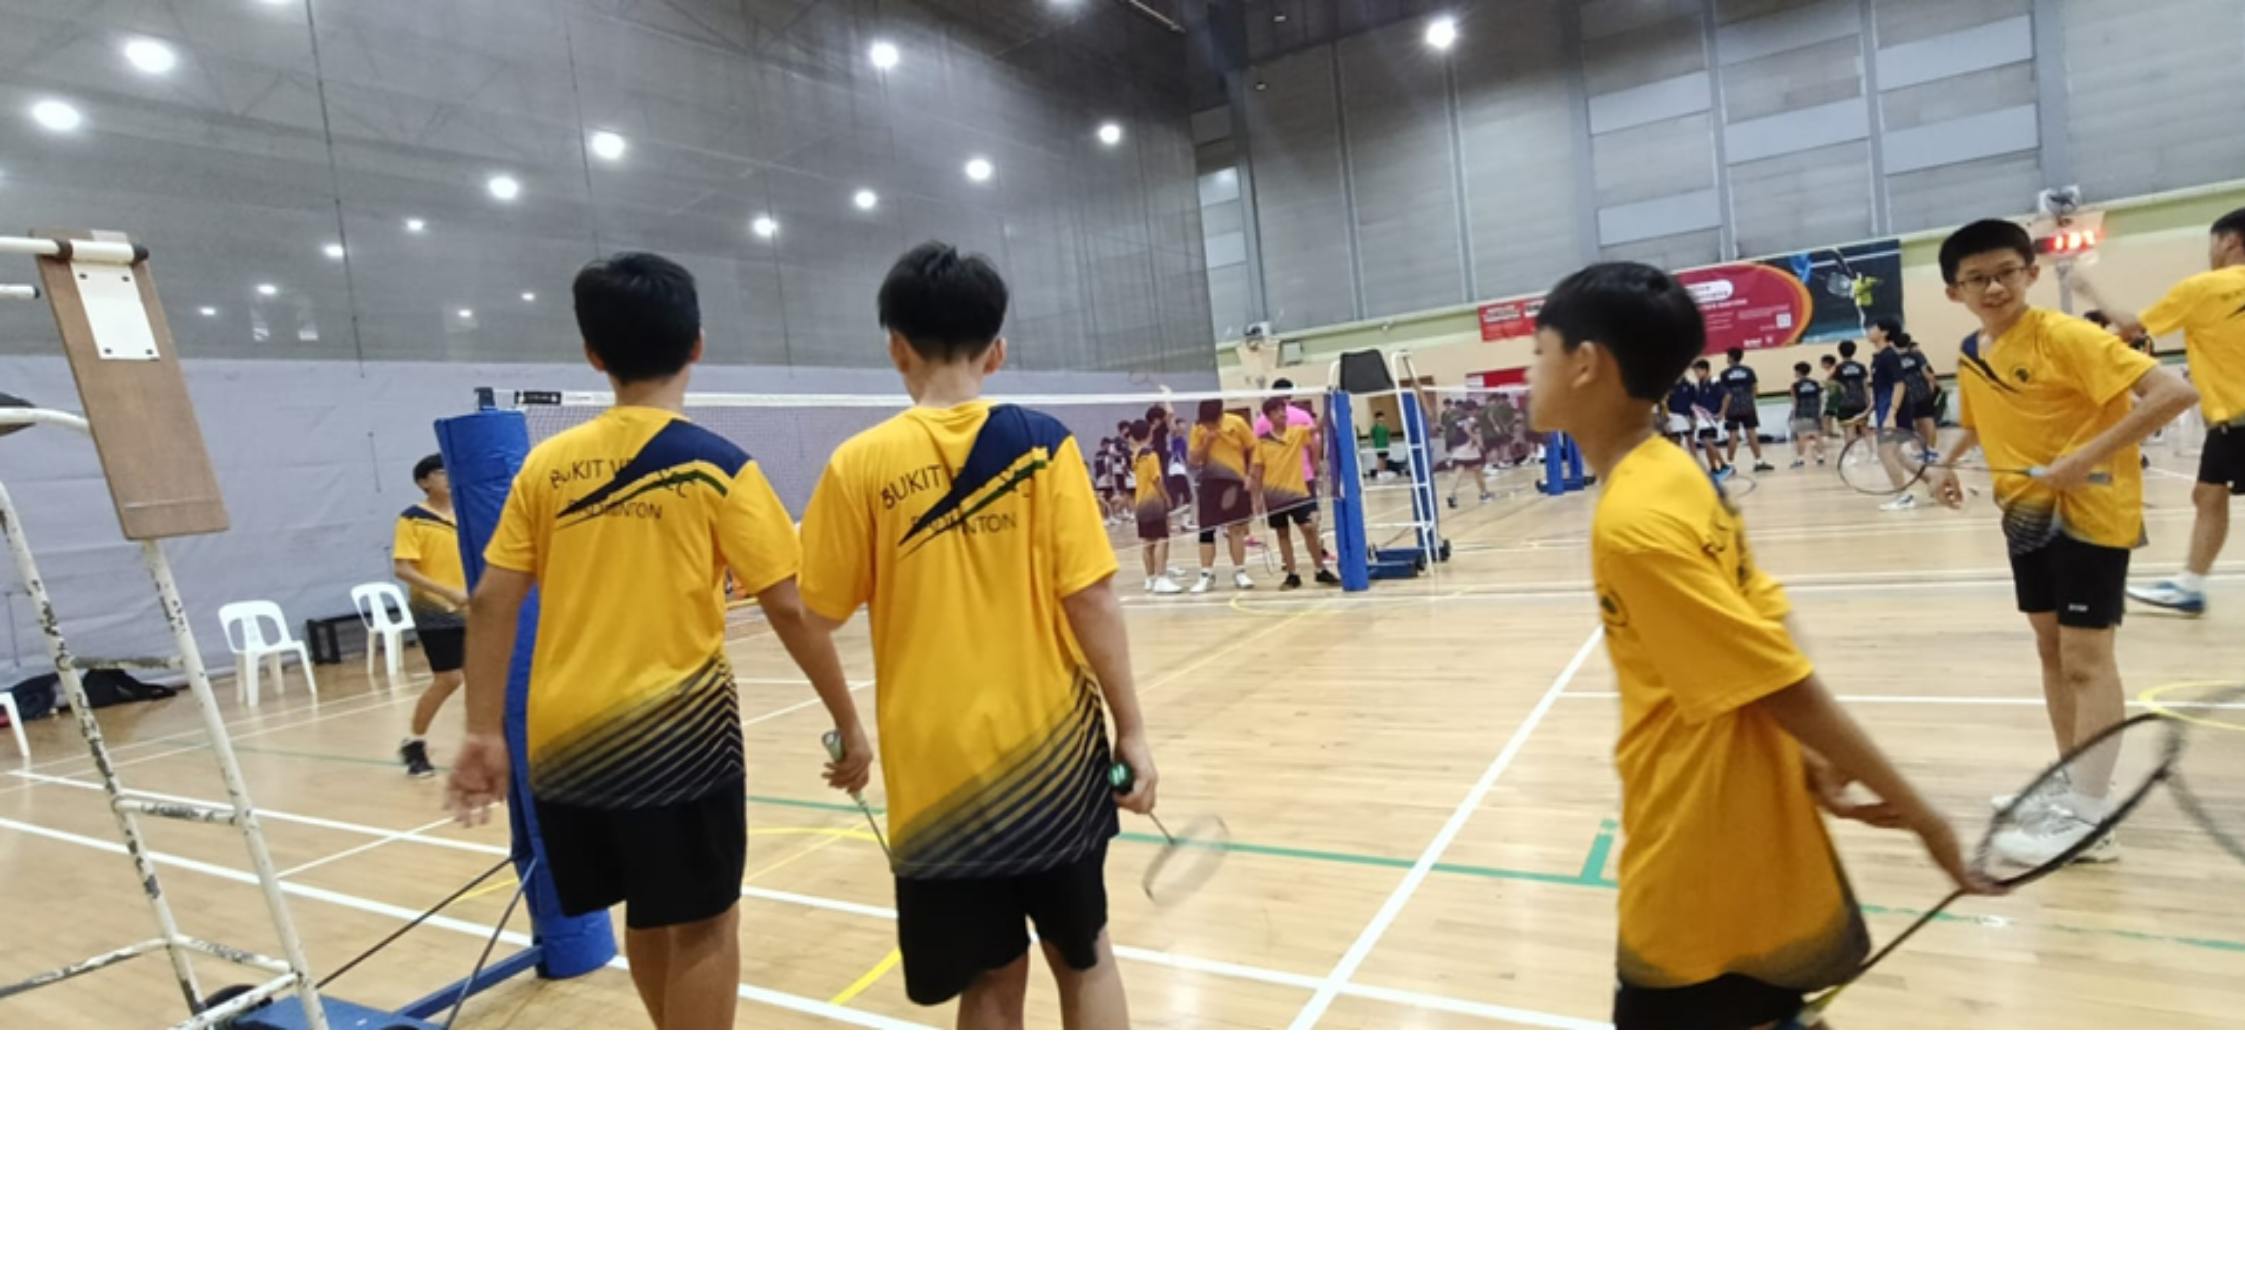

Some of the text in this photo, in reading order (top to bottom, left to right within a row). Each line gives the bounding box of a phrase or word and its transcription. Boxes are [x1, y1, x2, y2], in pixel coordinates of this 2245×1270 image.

[550, 459, 603, 489] BUKIT
[880, 465, 941, 510] BUKIT
[567, 498, 662, 519] DMINTON
